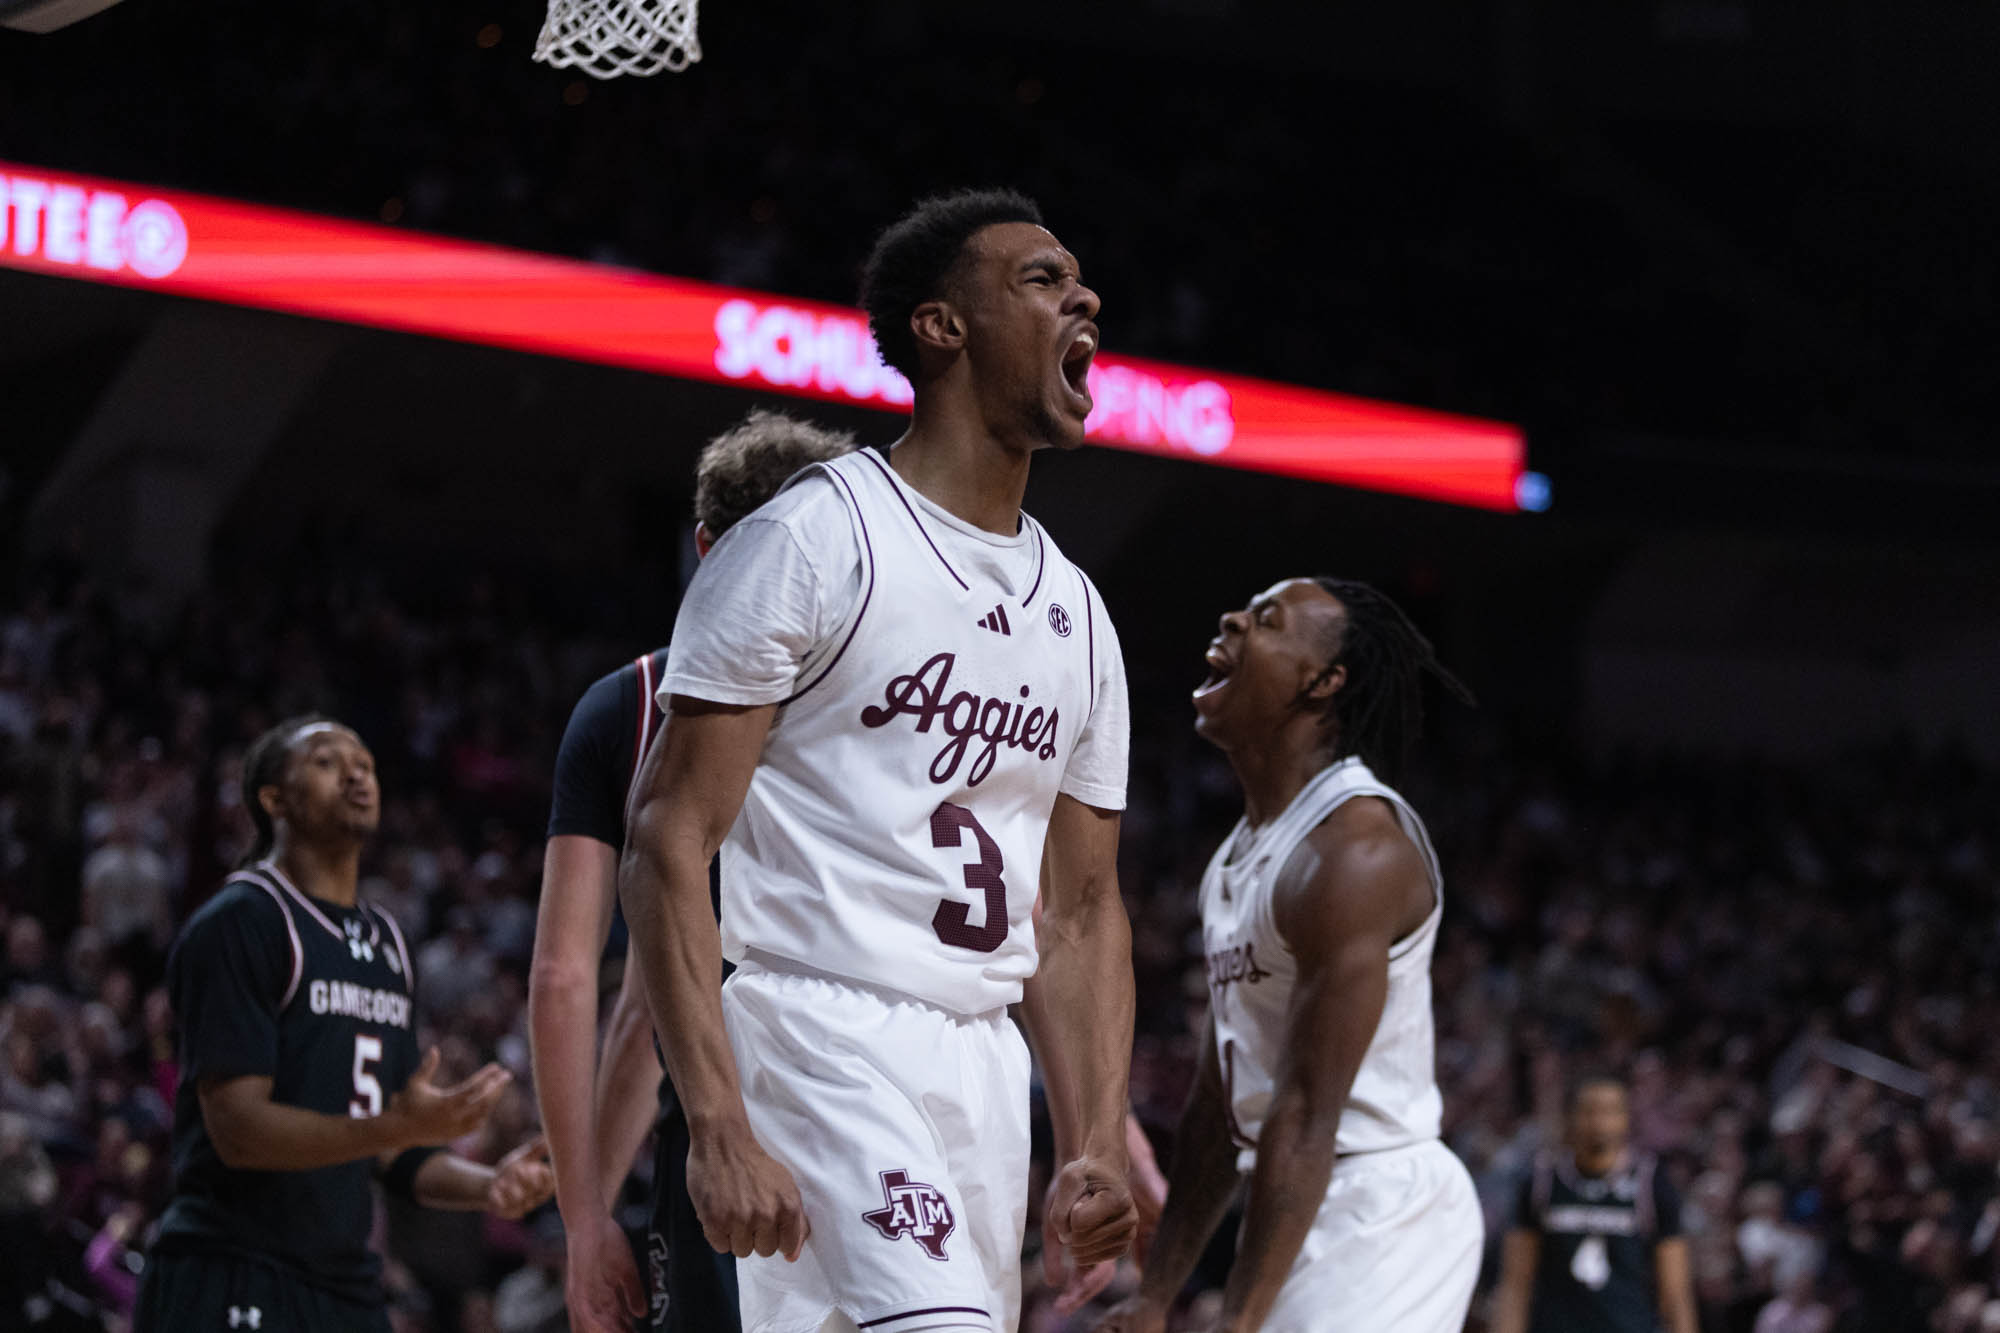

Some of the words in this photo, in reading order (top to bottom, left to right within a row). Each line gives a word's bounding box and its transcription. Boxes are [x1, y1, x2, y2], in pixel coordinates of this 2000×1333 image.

[1050, 606, 1069, 634] SEC
[861, 652, 1058, 787] Aggies
[930, 801, 1008, 953] 3
[349, 1033, 382, 1119] 5
